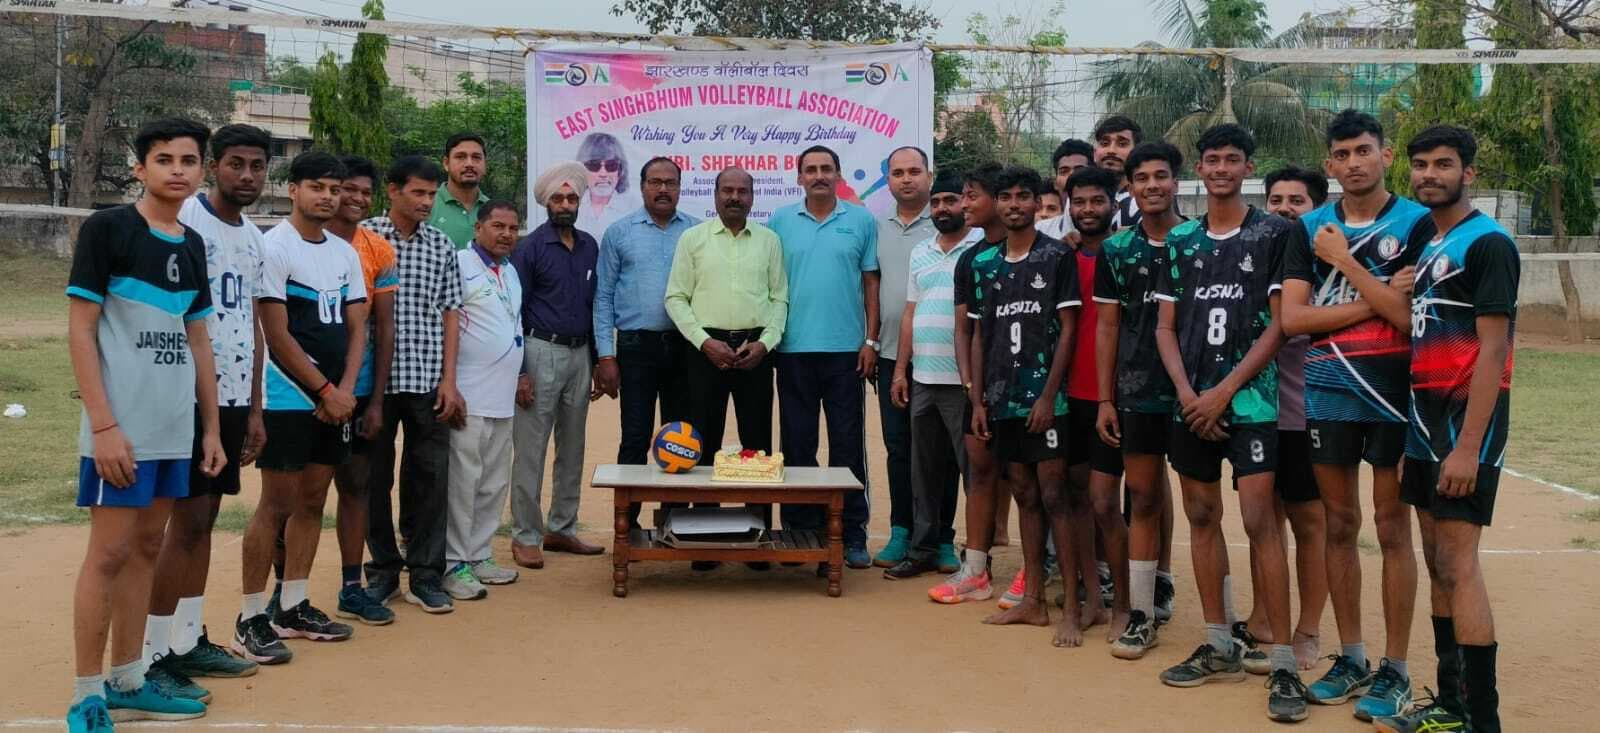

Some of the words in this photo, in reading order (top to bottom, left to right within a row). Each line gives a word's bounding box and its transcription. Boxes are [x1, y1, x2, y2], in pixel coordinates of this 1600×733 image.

[321, 19, 367, 29] SPARTAN
[1472, 50, 1518, 58] SPARTAN
[645, 64, 709, 78] झारखण्ड
[773, 61, 809, 78] दिवस
[555, 107, 595, 140] EAST
[598, 86, 693, 123] SINGHBHUM
[697, 84, 793, 109] VOLLEYBALL
[797, 91, 900, 139] ASSOCIATION
[630, 125, 675, 145] Wishing
[681, 125, 706, 143] You
[709, 125, 724, 141] A
[731, 125, 757, 145] Very
[761, 124, 801, 145] Happy
[804, 123, 856, 145] Birthday
[702, 155, 778, 171] SHEKHAR
[784, 156, 801, 170] B
[753, 176, 783, 185] resident
[680, 188, 712, 198] olleyball
[166, 253, 180, 283] 6
[318, 289, 343, 324] 07
[1207, 307, 1227, 346] 8
[1010, 321, 1021, 354] 9
[1046, 428, 1058, 448] 9
[1310, 429, 1321, 448] 5
[665, 442, 695, 458] COSCO
